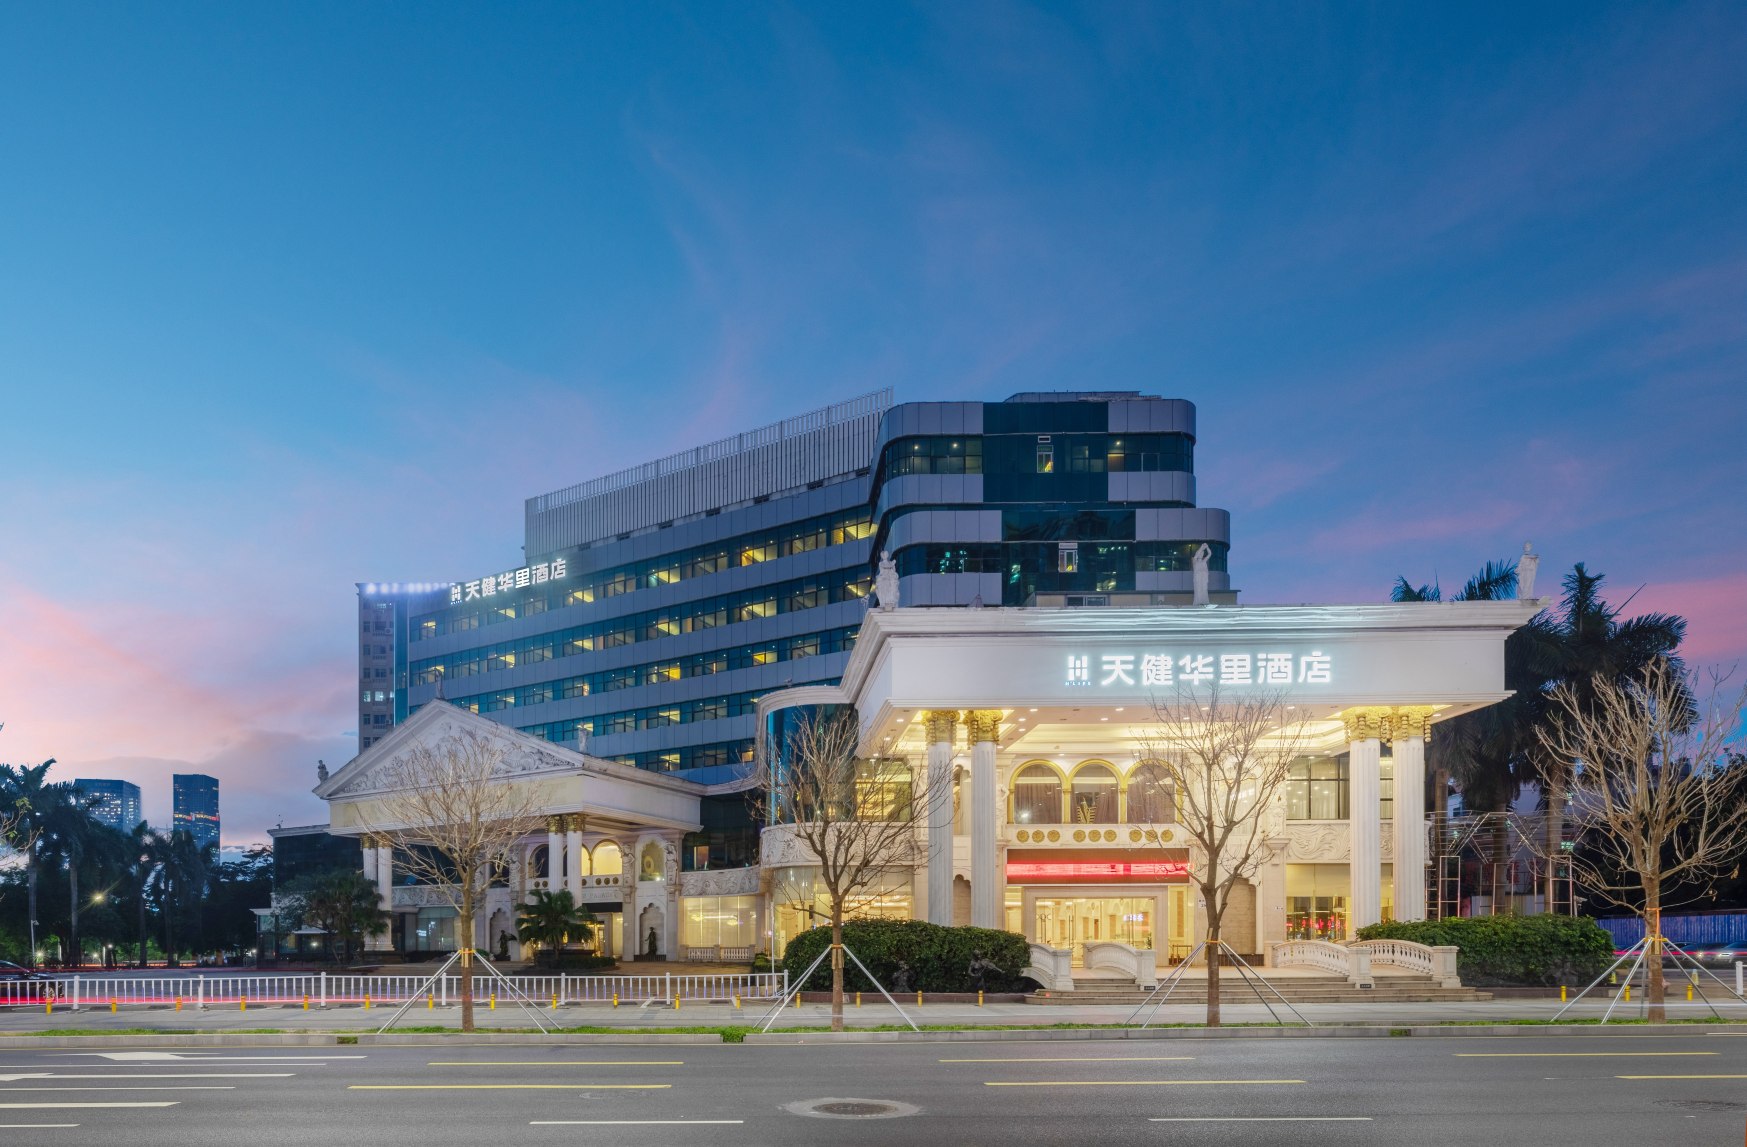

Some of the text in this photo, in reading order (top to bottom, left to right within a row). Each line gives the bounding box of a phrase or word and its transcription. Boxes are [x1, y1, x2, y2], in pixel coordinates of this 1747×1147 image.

[465, 558, 566, 601] 天健华里酒店
[1101, 651, 1331, 686] 天健华里酒店
